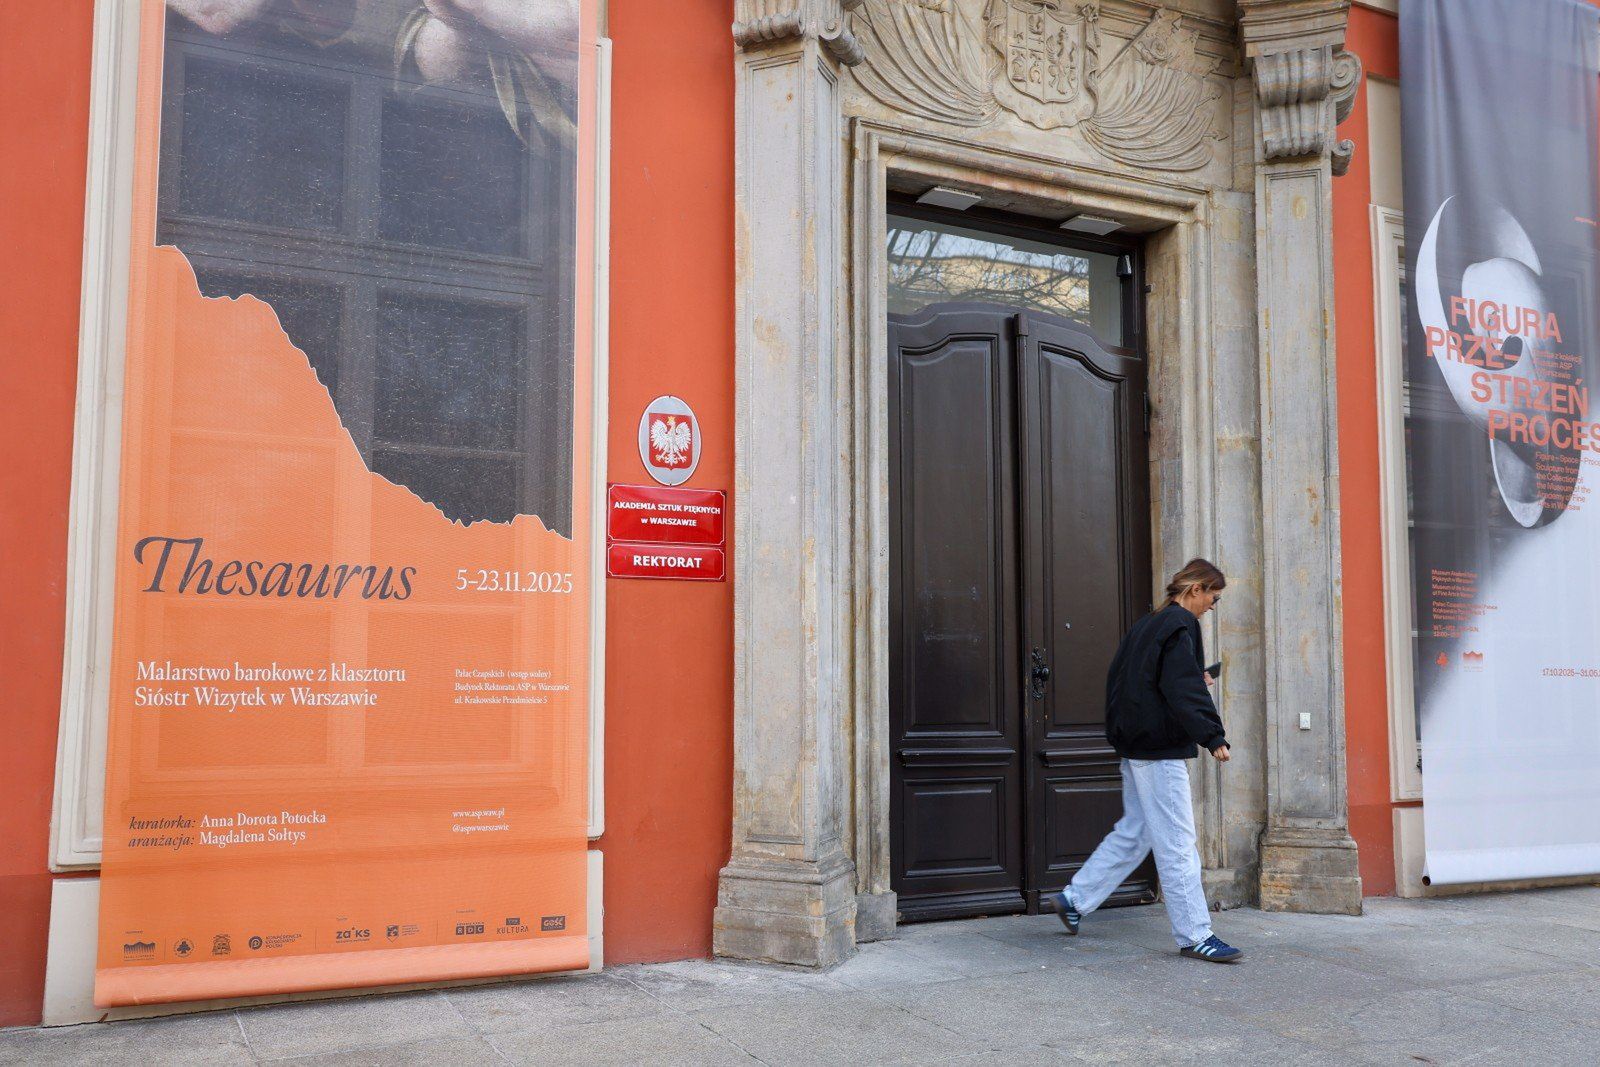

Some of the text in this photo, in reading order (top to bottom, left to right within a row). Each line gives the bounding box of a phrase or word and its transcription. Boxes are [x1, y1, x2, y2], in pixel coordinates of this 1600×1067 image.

[1450, 295, 1562, 344] FIGURA
[1471, 371, 1588, 418] STRZEŃ
[614, 501, 720, 514] AKADEMIA SZTUK PIĘKNYCH
[650, 518, 697, 526] WARSZAWIE
[134, 536, 417, 600] Thesaurus
[633, 555, 702, 568] REKTORAT
[136, 661, 406, 682] Malarstwo barokowe z klasztoru
[516, 683, 530, 692] ASP
[135, 686, 378, 712] Sióstr Wizytek w Warszawie
[129, 811, 326, 830] kuratorka: Anna Dorota Potocka
[452, 808, 505, 819] www.asp.waw.pl
[128, 828, 306, 850] aranżacja: Magdalena Sołtys
[496, 926, 528, 935] KULTURA
